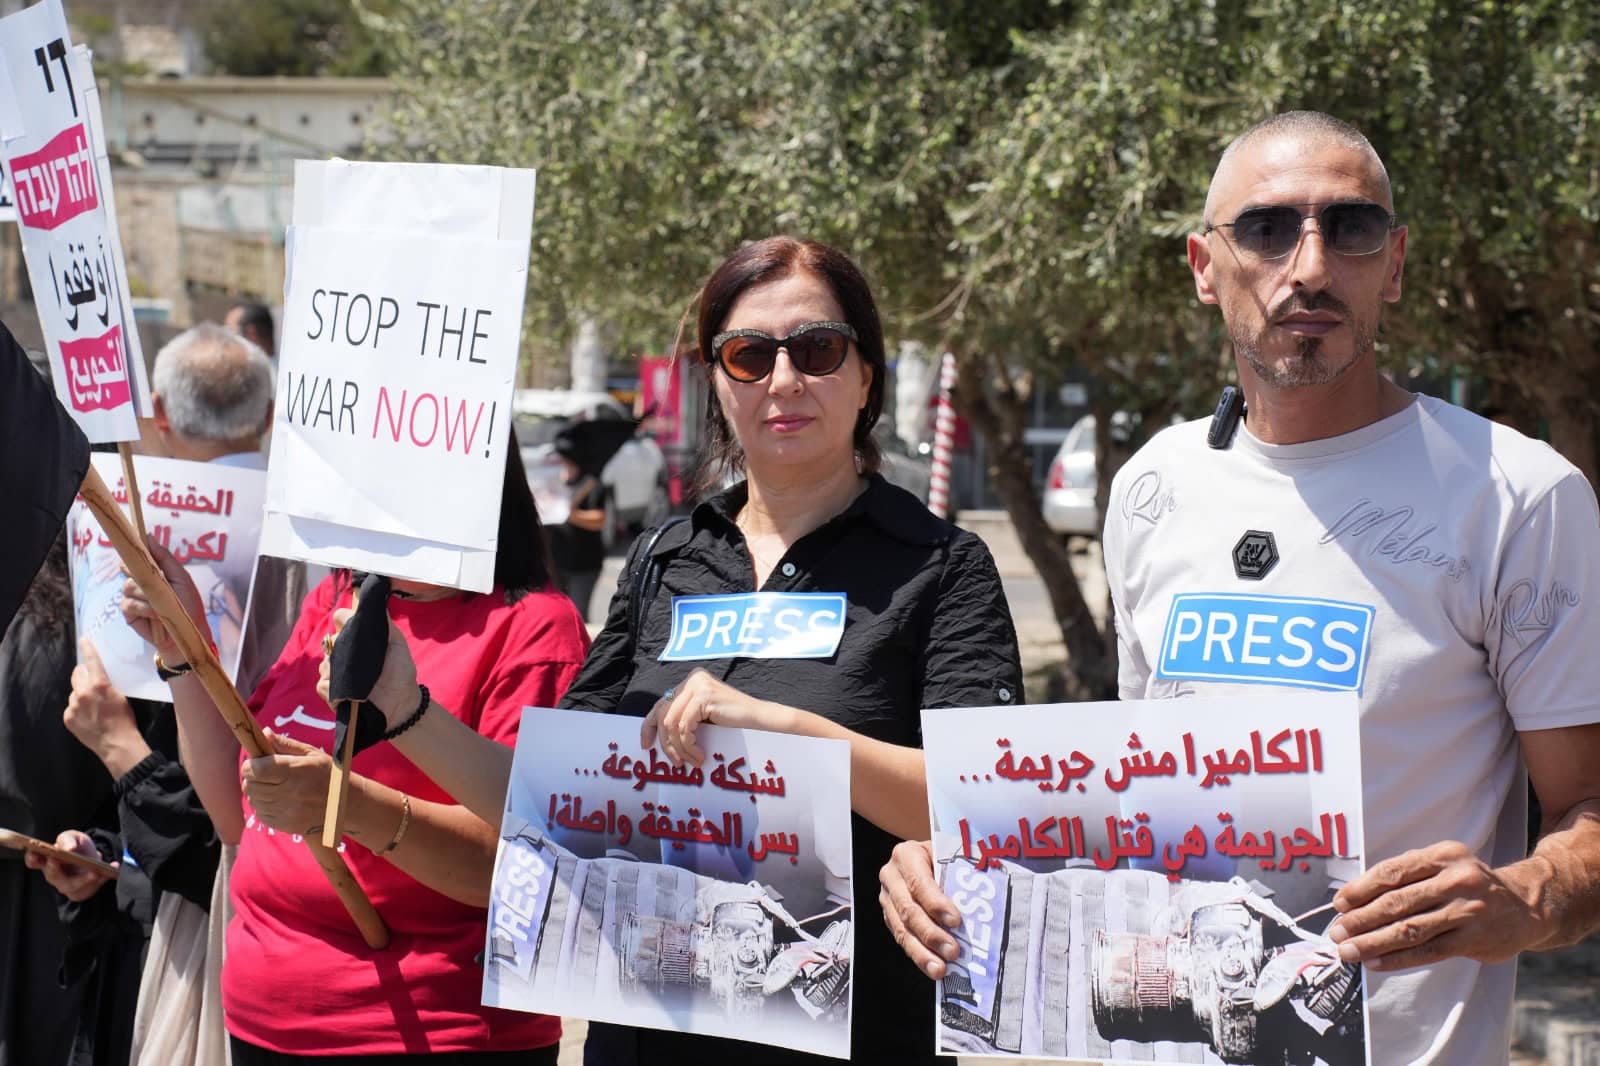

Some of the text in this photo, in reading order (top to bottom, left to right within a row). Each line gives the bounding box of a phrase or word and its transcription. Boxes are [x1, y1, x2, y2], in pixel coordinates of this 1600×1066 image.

[34, 37, 78, 118] די
[307, 289, 492, 364] STOP THE
[70, 336, 126, 405] لتجويع
[287, 371, 496, 459] WAR NOW!
[146, 480, 235, 518] الحقيقة
[173, 530, 228, 564] لكن
[675, 607, 838, 652] PRESS
[1169, 611, 1360, 673] PRESS
[710, 753, 786, 802] شبكة
[1104, 732, 1176, 791] مش
[1182, 728, 1324, 787] الكاميرا
[548, 793, 799, 863] بس الحقيقة واصلة!
[959, 812, 1349, 881] الجريمة هي قتل الكاميرا
